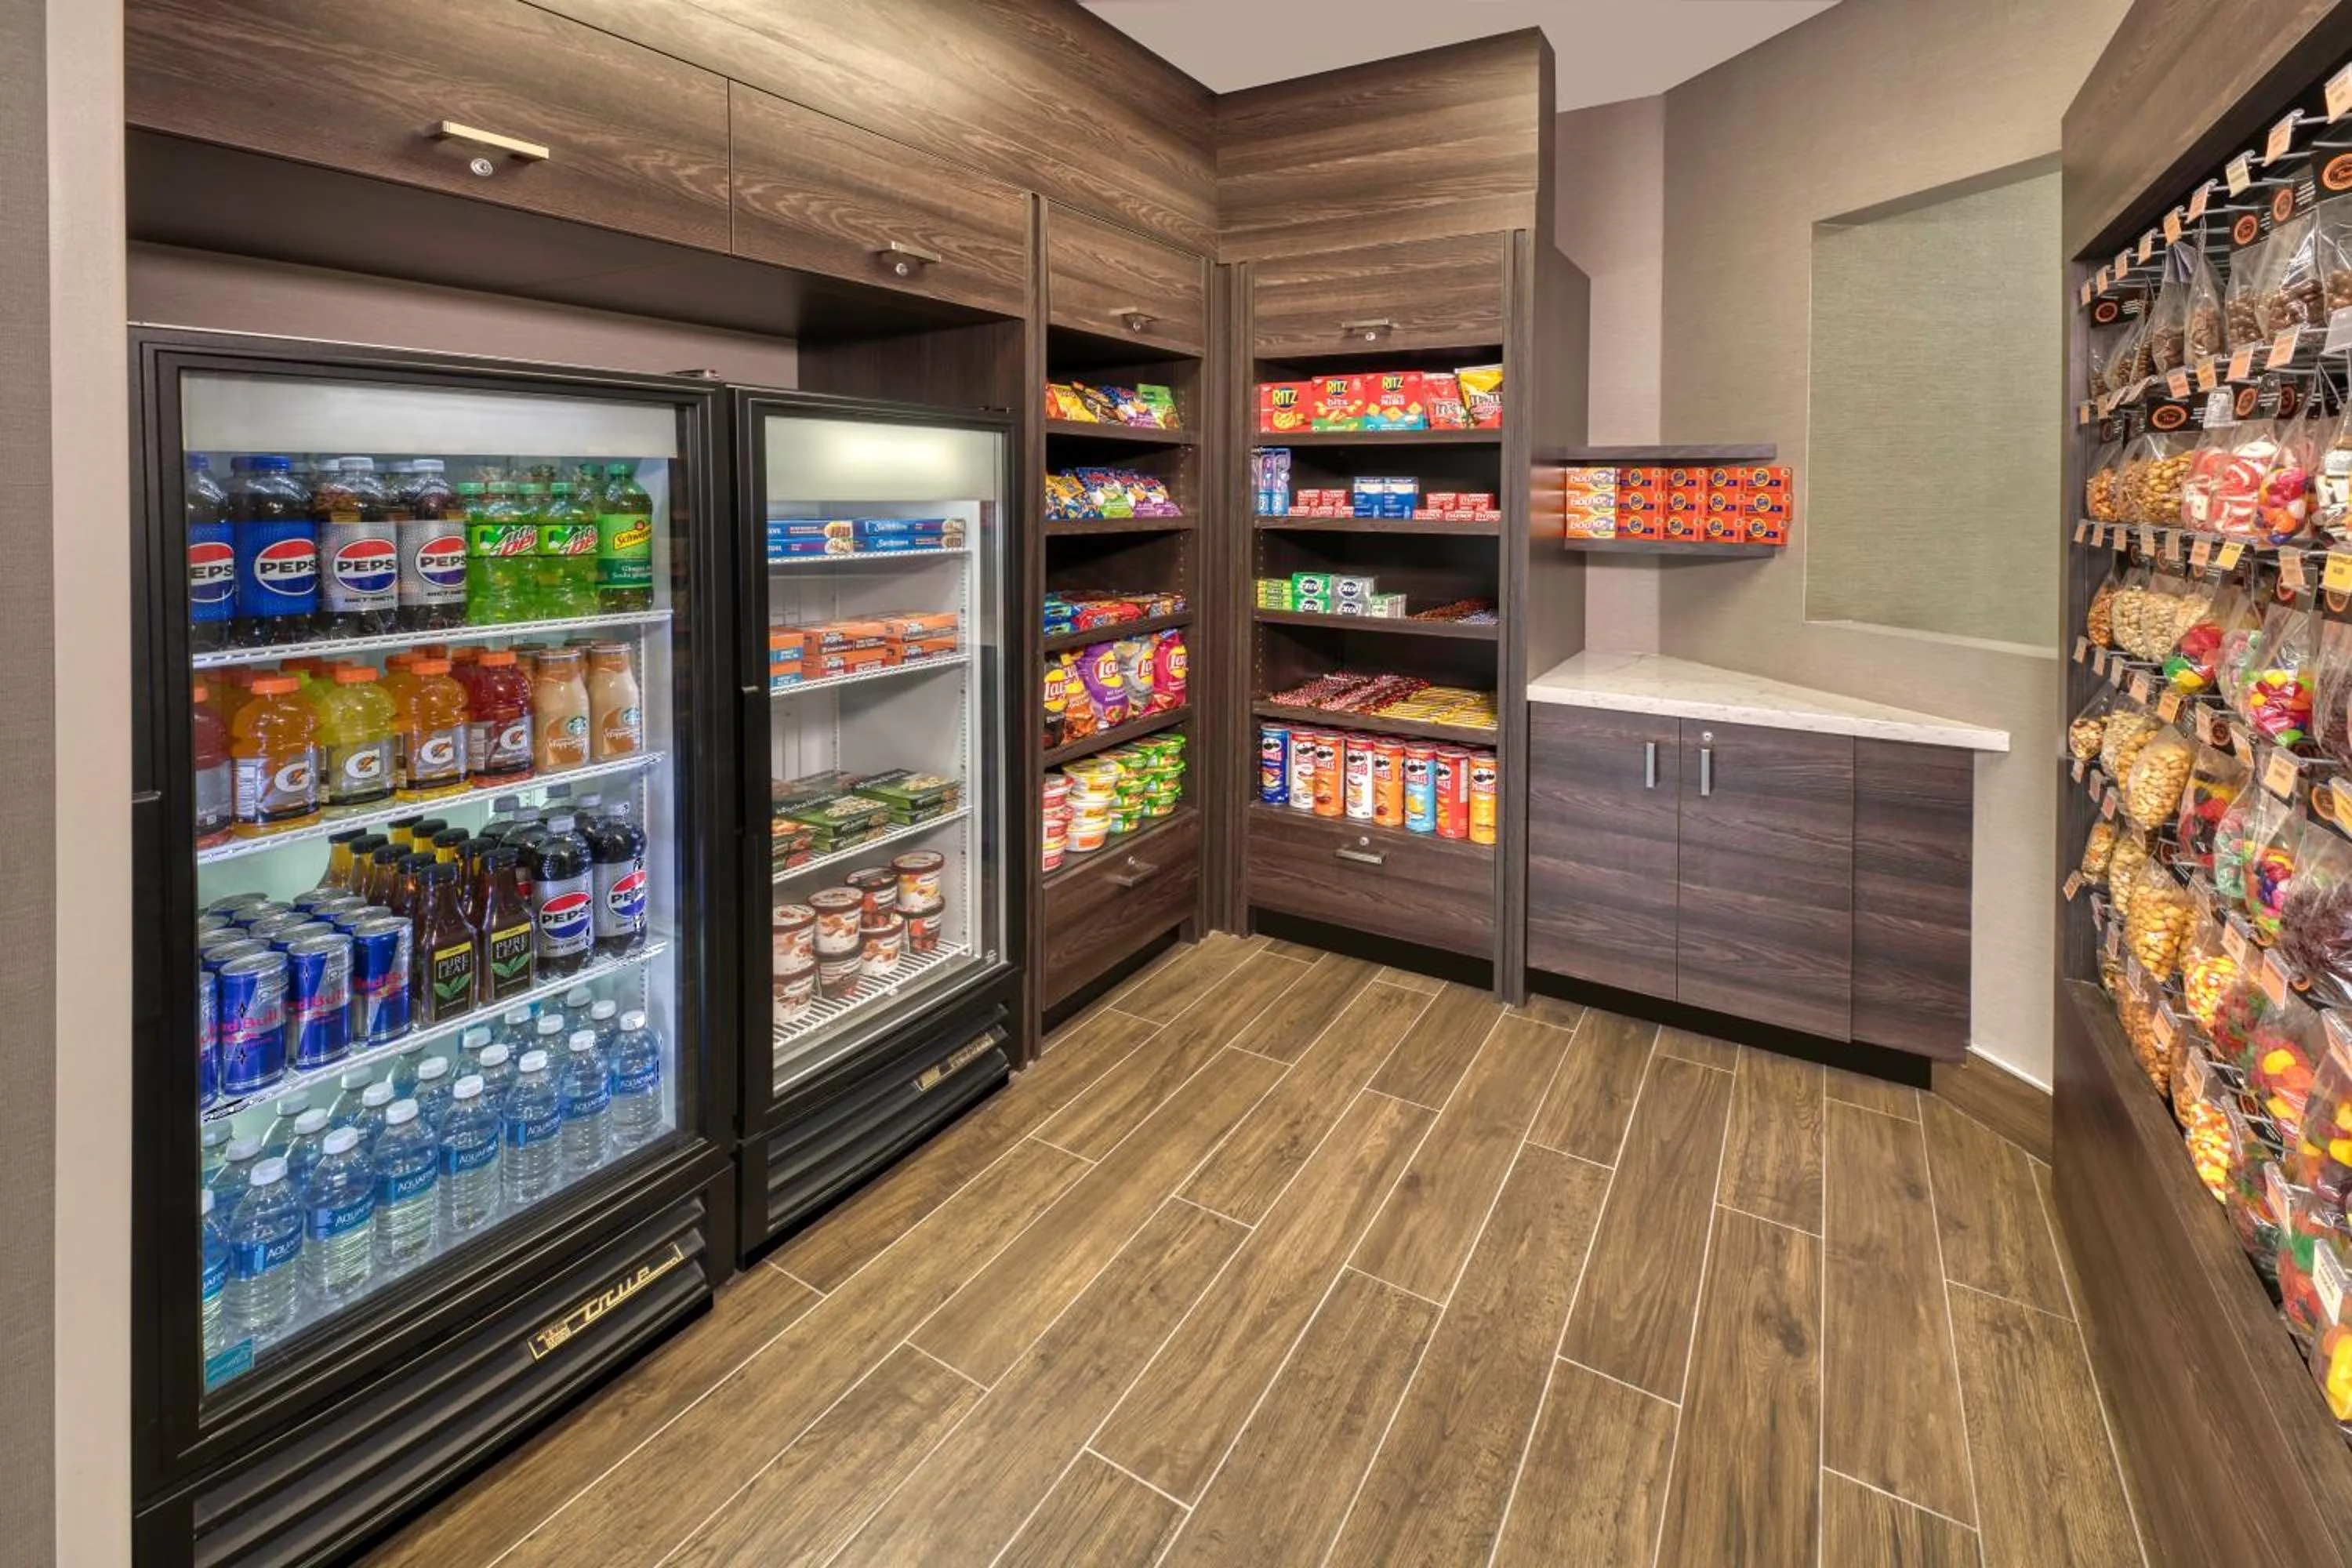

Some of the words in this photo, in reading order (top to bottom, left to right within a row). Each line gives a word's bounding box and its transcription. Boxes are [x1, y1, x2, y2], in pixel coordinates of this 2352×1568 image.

[1327, 380, 1348, 393] RITZ
[1382, 376, 1404, 390] RITZ
[1272, 389, 1298, 407] RITZ
[260, 559, 319, 575] PEPS
[337, 557, 397, 573] PEPS
[419, 554, 466, 568] PEPS
[191, 564, 233, 579] EPS
[611, 887, 643, 904] PEP
[540, 906, 590, 924] PEPS
